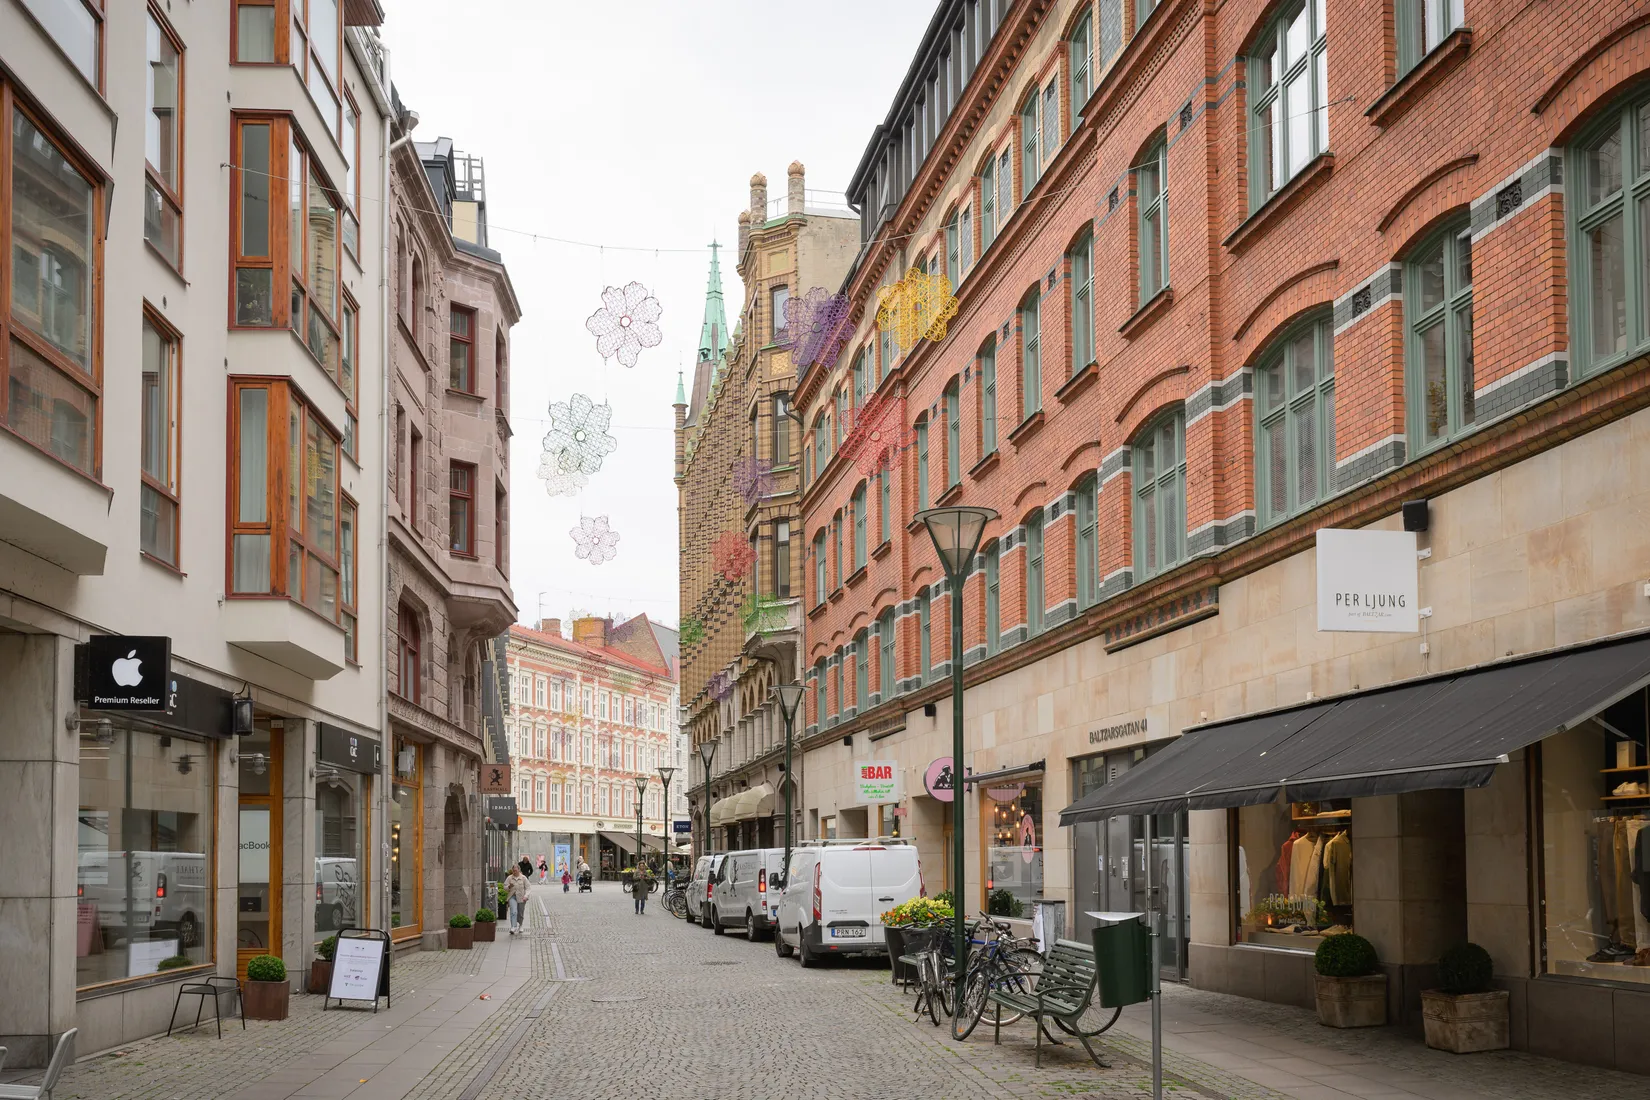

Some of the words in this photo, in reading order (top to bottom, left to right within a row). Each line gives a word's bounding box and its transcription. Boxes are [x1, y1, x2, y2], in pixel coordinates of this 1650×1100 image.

[1335, 592, 1360, 607] PER
[1365, 593, 1406, 609] LJUNG
[94, 696, 129, 704] Premium
[130, 696, 160, 704] Reseller
[1089, 720, 1140, 744] BALTZARSGATAN
[1140, 718, 1148, 732] 41
[868, 766, 892, 780] BAR
[239, 841, 270, 850] acBook
[1270, 893, 1285, 910] PER
